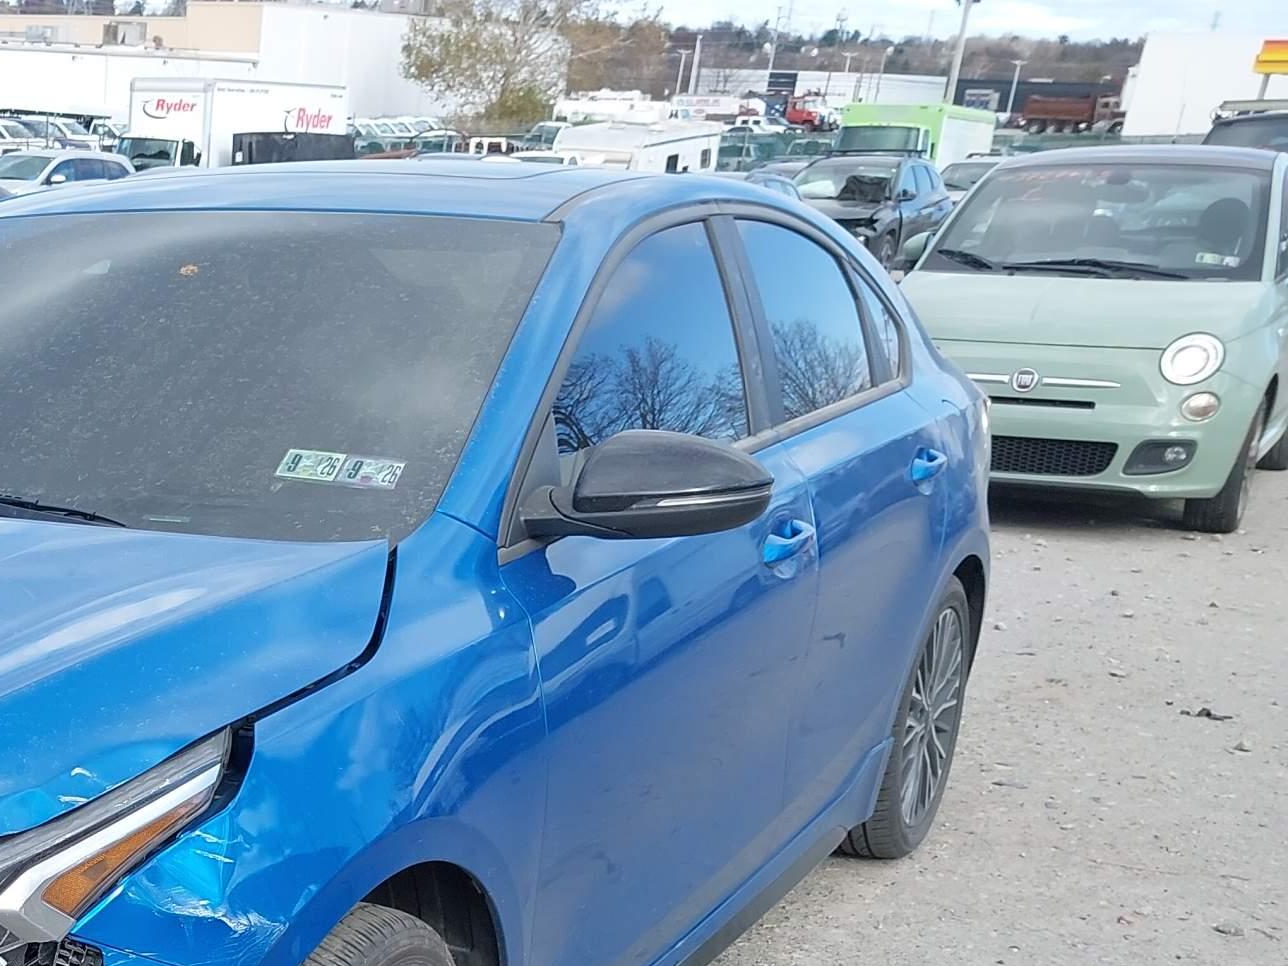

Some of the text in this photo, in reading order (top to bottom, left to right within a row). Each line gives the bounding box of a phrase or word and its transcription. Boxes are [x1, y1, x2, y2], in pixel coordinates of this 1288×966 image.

[155, 98, 197, 114] Ryder
[296, 107, 333, 133] Ryder
[287, 453, 340, 476] 9 26
[347, 460, 401, 484] 9 26
